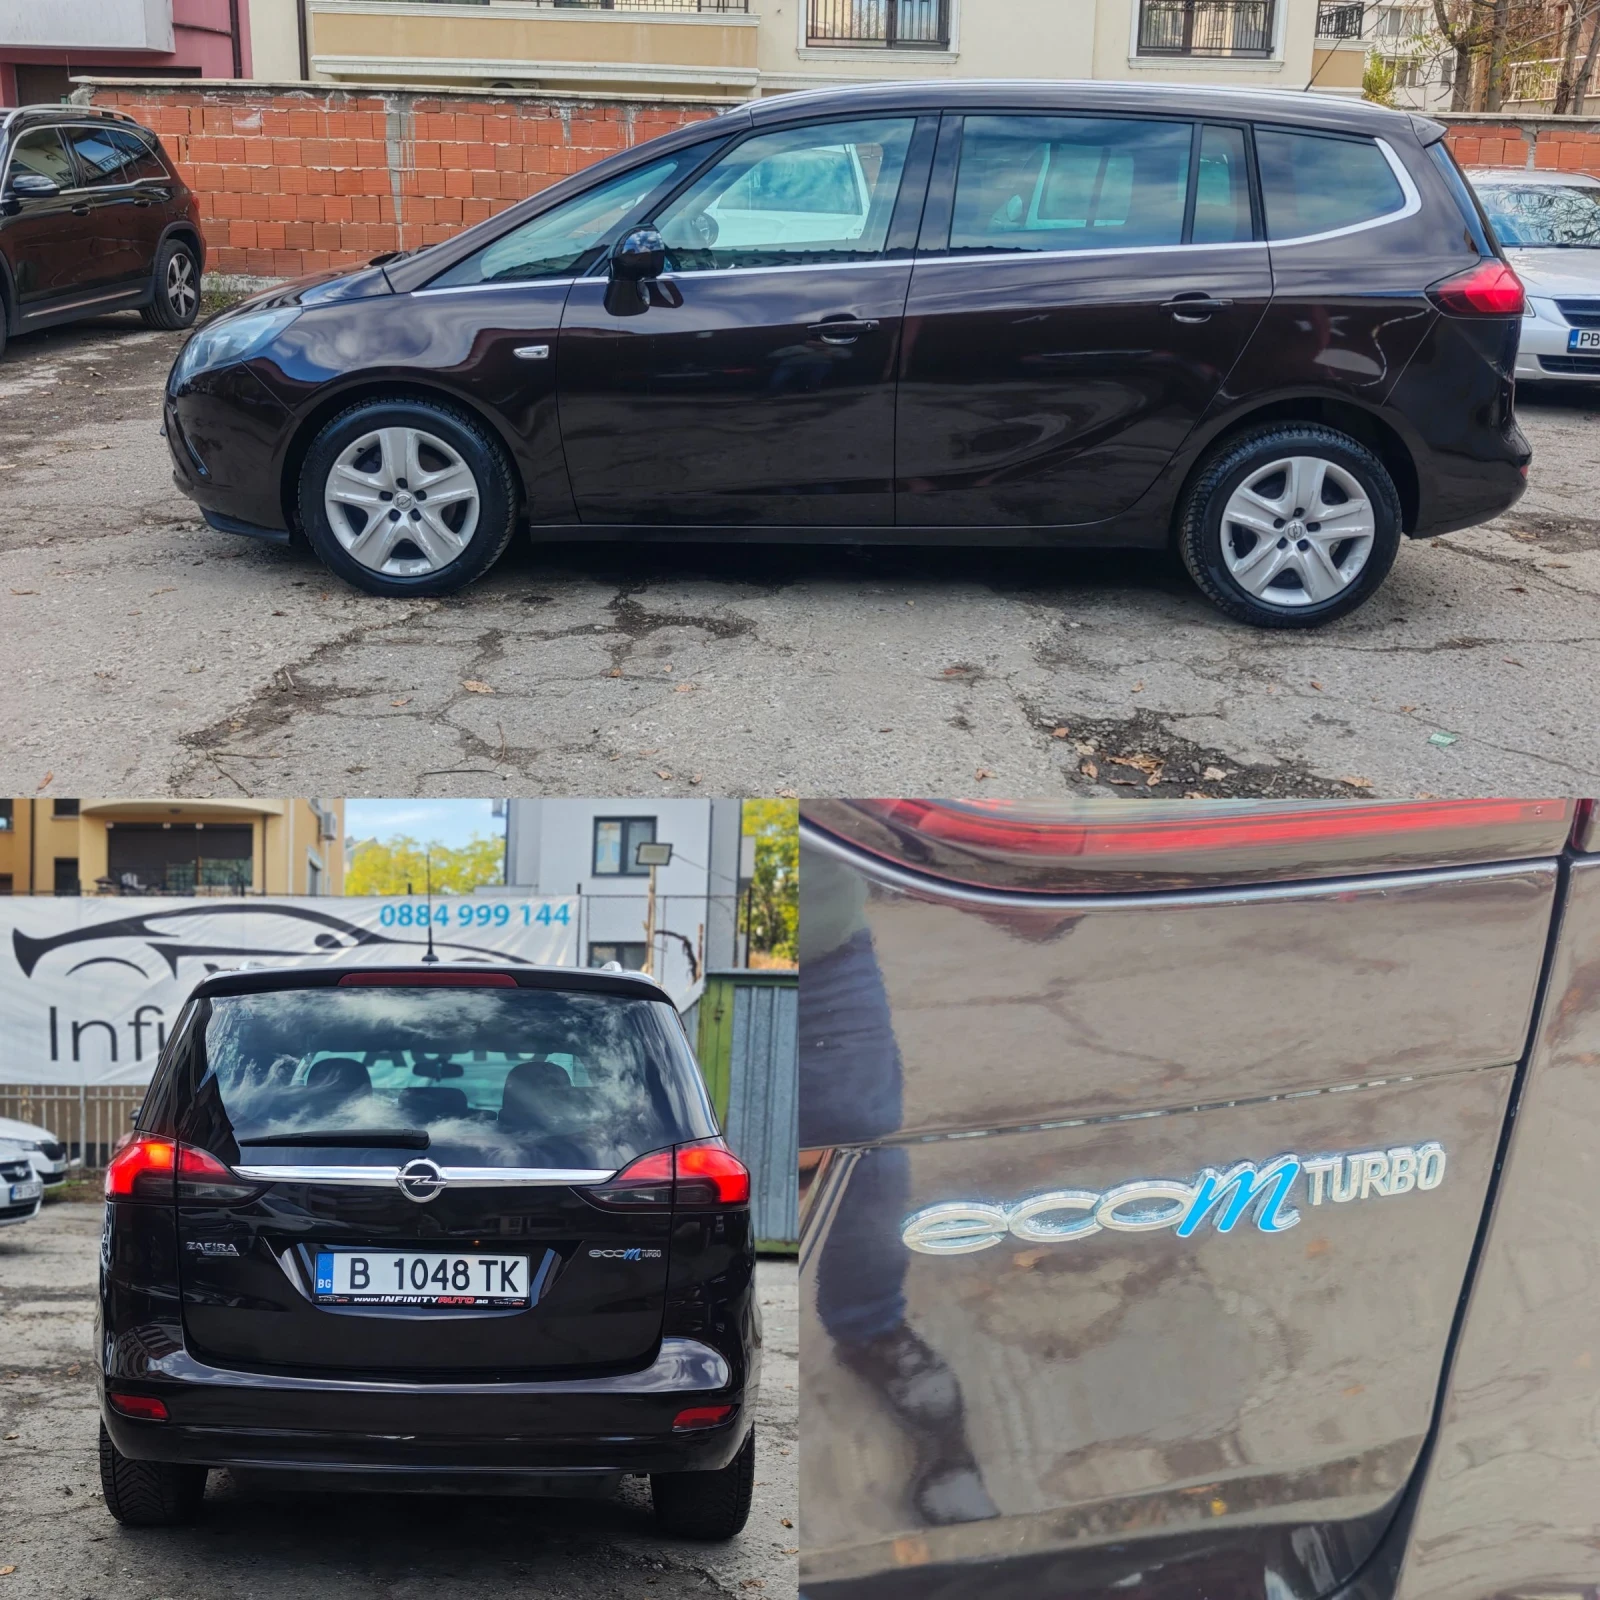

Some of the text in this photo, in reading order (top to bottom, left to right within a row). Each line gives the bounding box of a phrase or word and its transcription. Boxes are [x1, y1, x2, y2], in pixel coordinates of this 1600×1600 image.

[1580, 332, 1600, 347] PB
[379, 904, 570, 926] 0884 999 144
[1301, 1141, 1447, 1205] TURBO
[186, 1241, 237, 1252] ZAFIRA
[317, 1279, 332, 1289] BG
[349, 1257, 520, 1293] B 1048 TK
